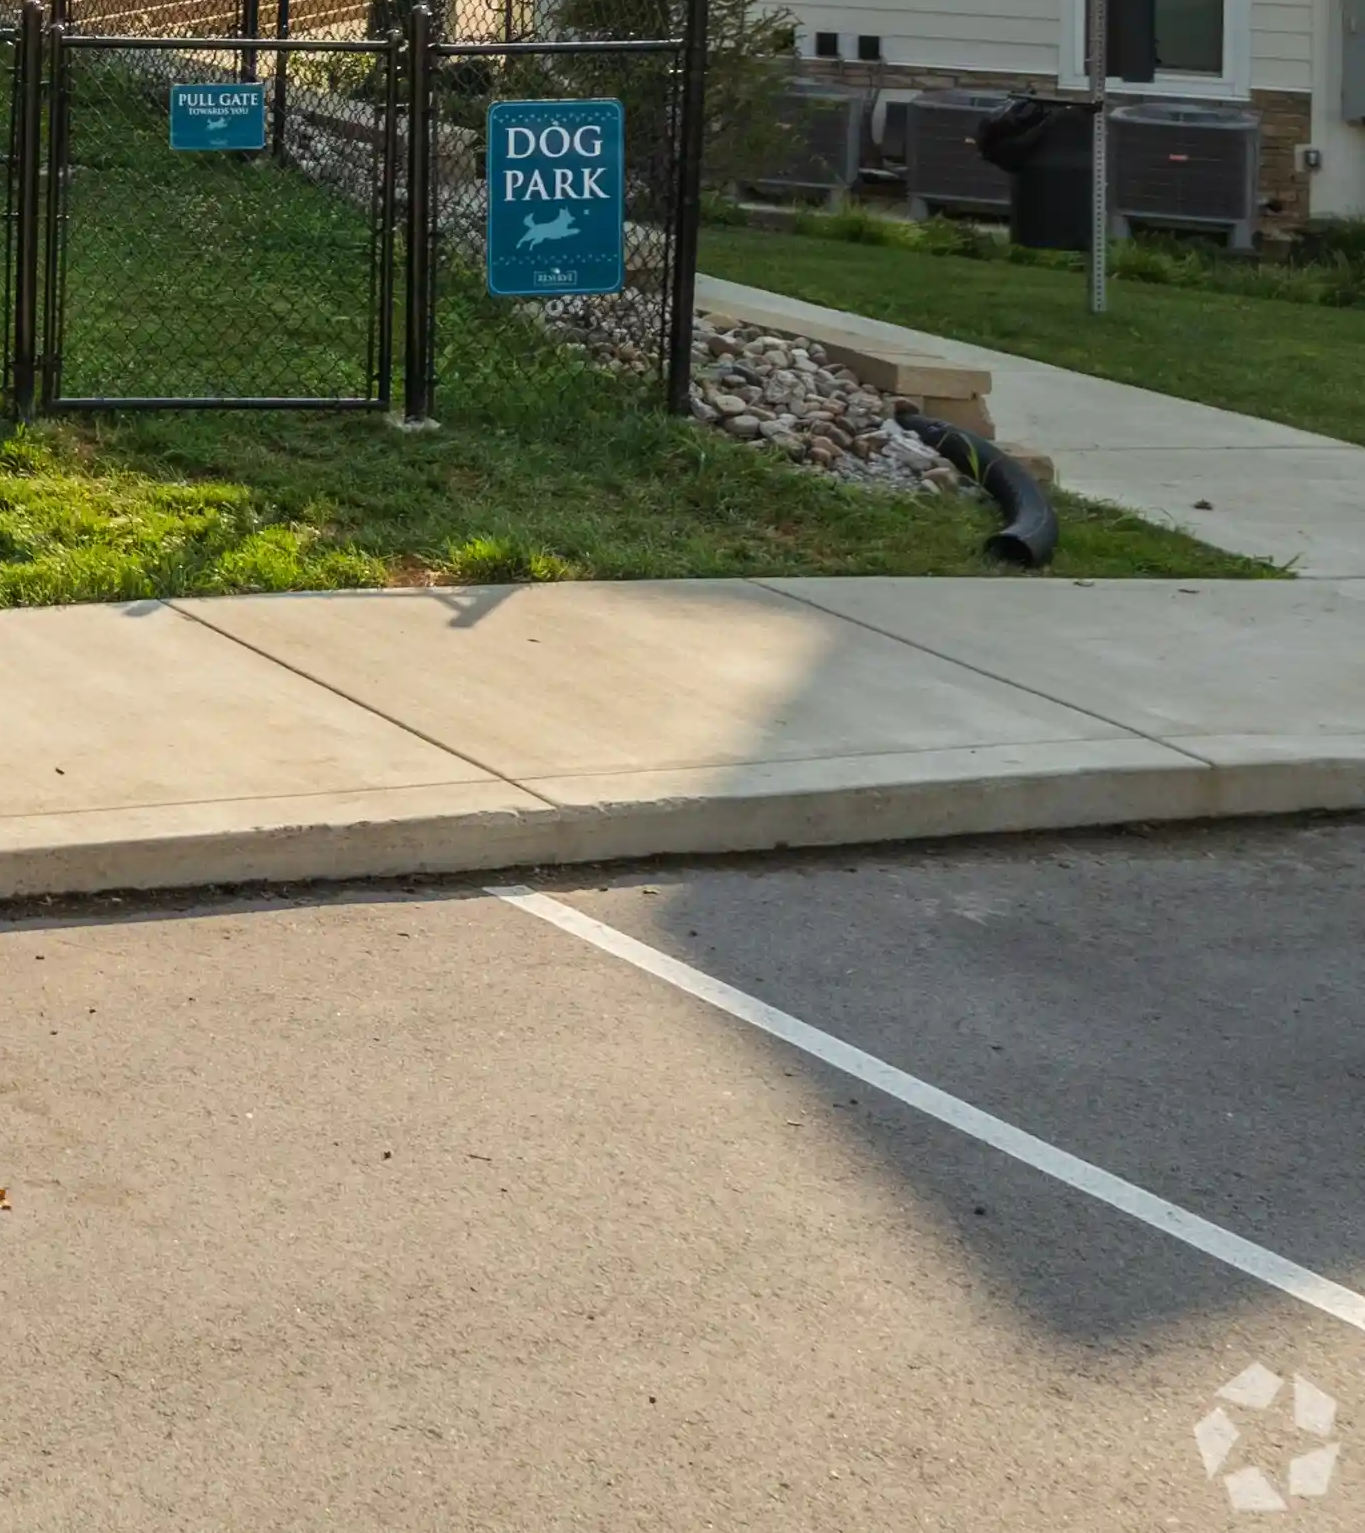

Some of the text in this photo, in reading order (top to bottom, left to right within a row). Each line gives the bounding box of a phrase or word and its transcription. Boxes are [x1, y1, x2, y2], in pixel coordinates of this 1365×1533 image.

[179, 93, 258, 106] PULL GATE
[231, 107, 248, 115] YOU
[505, 125, 603, 159] DOG
[503, 167, 610, 202] PARK
